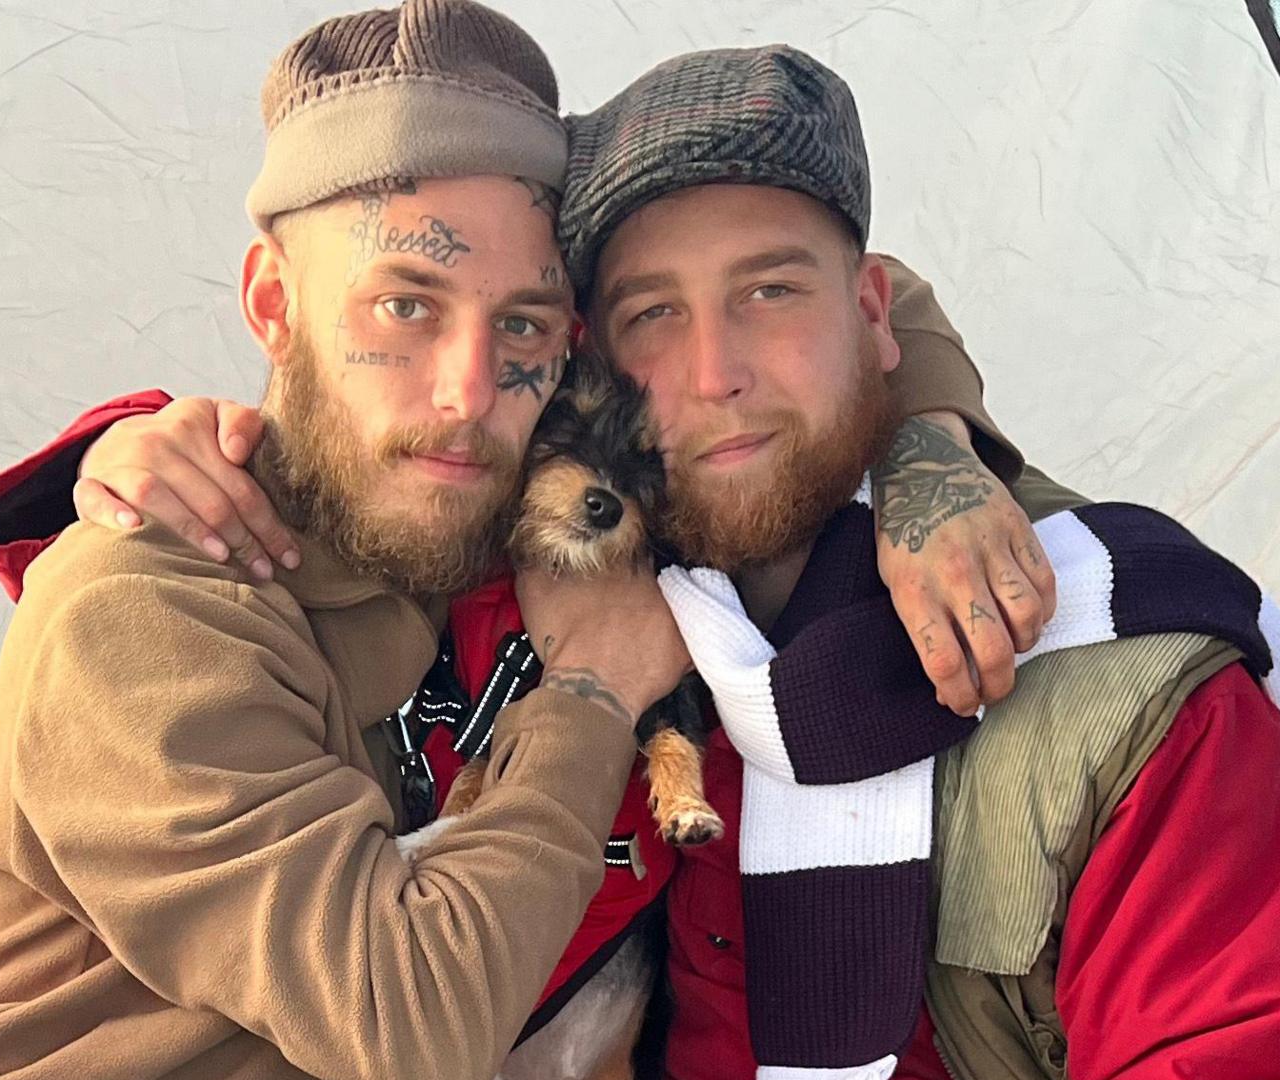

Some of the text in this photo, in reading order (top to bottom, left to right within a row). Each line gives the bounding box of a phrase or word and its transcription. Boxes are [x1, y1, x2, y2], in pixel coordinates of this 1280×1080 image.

[346, 215, 471, 282] Blessed
[345, 351, 411, 367] MADE IT
